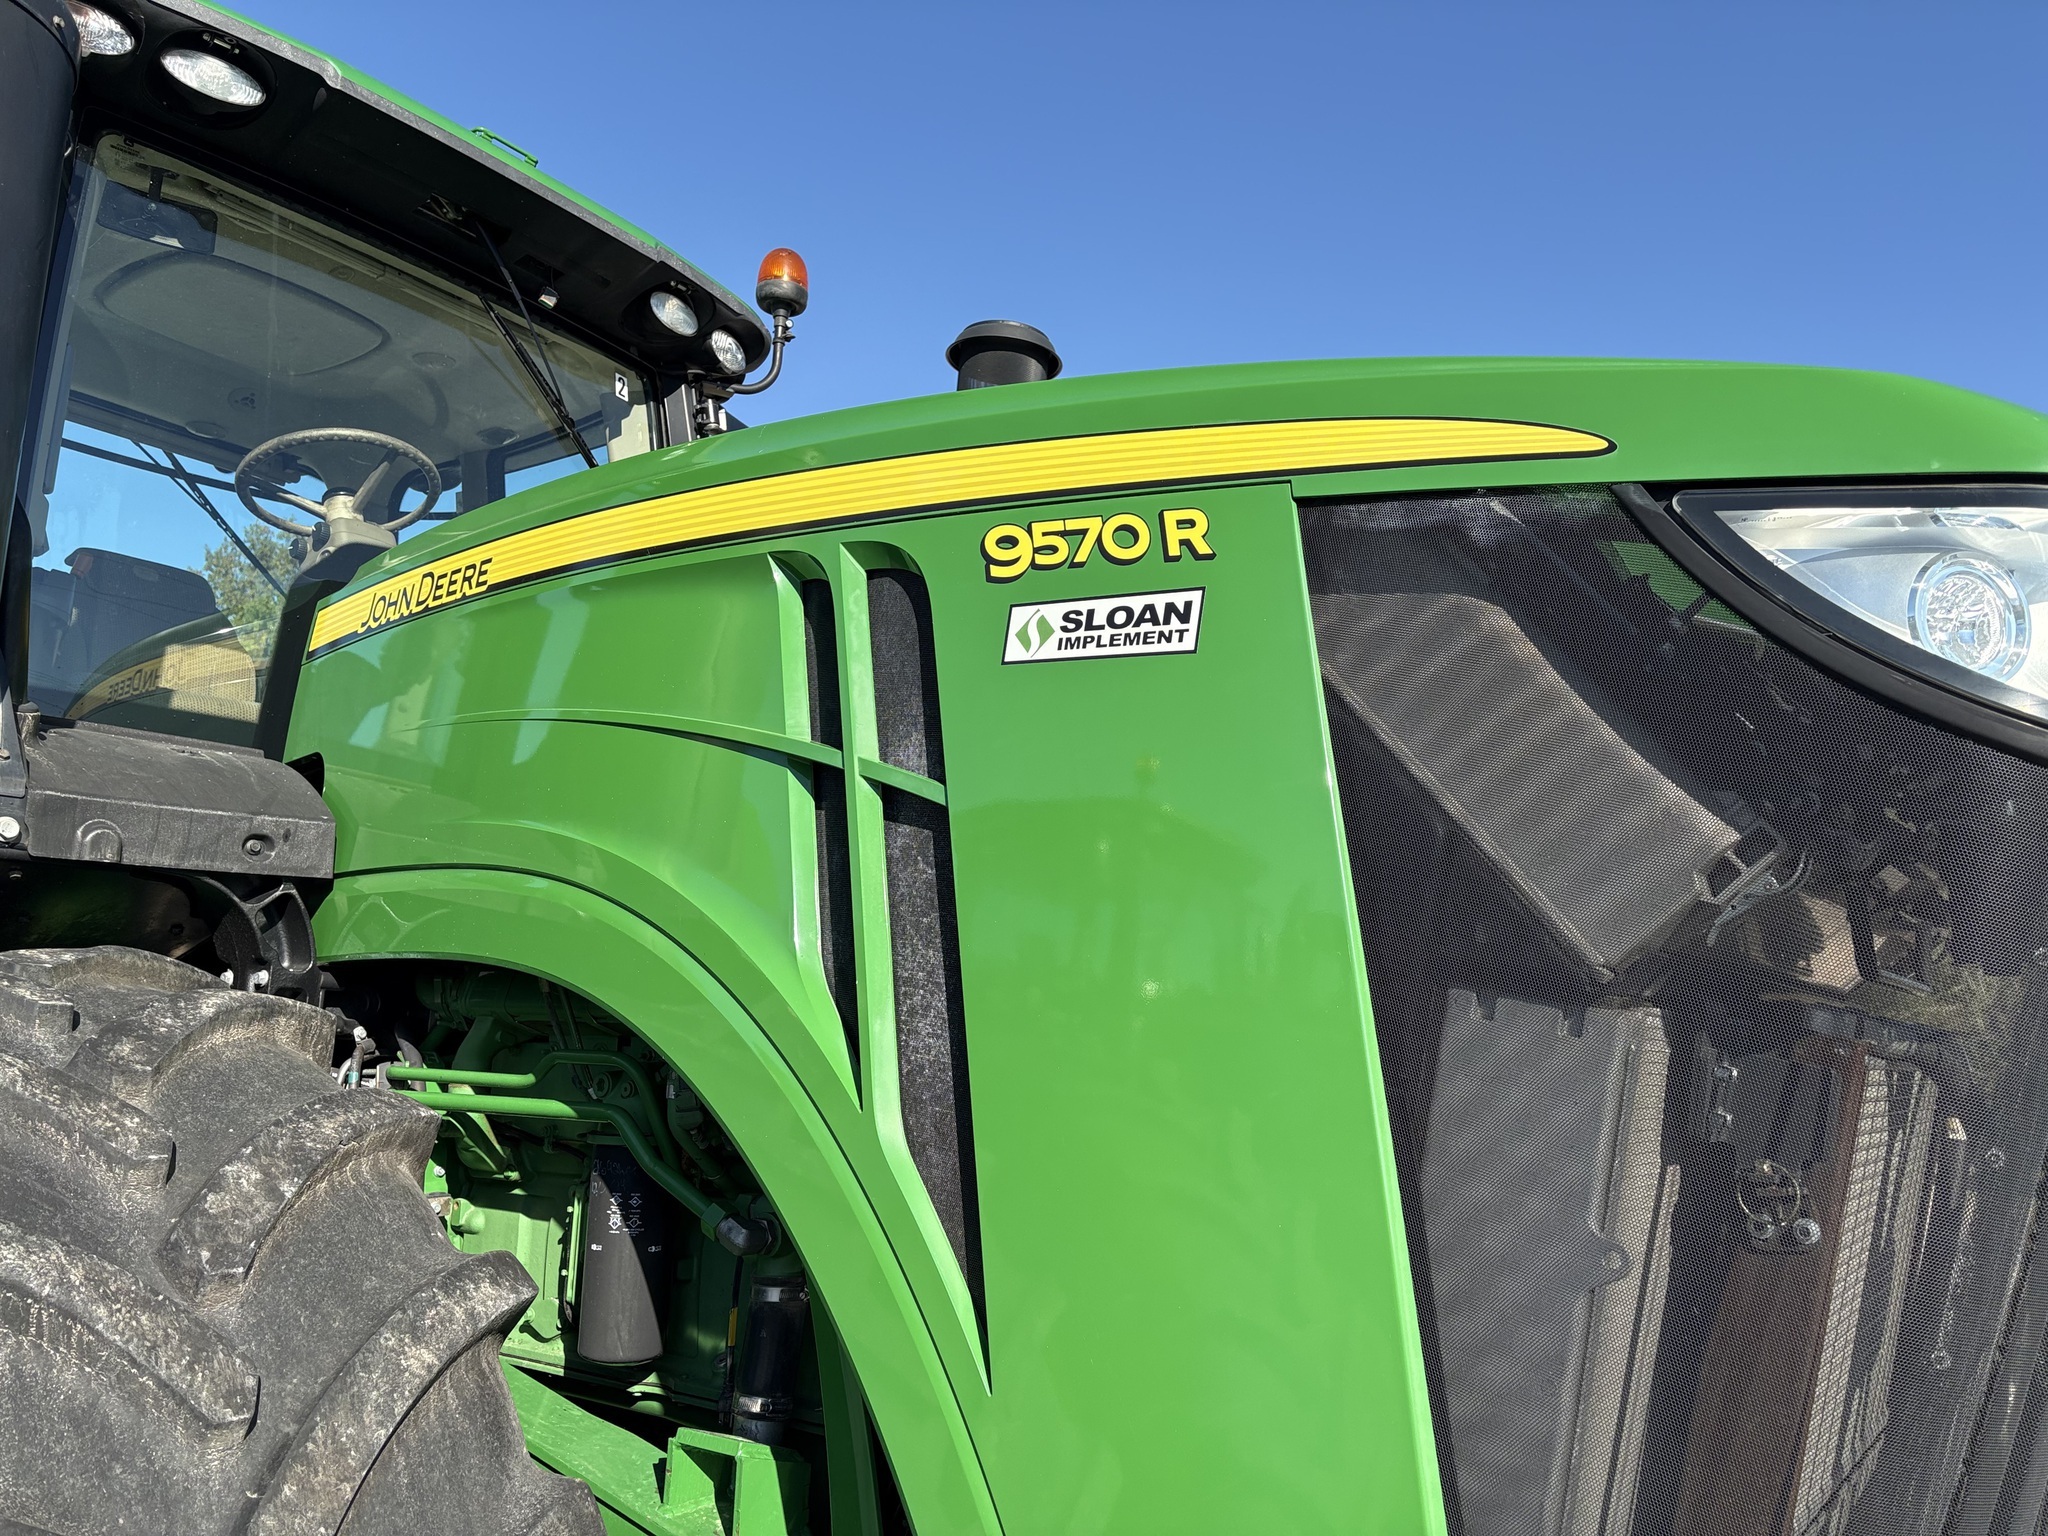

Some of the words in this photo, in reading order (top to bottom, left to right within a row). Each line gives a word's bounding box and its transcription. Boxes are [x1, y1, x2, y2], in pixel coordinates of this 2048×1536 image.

[980, 513, 1151, 584] 9570
[1158, 507, 1217, 563] R
[360, 582, 416, 630] JOHN
[415, 557, 493, 607] DEERE
[1060, 600, 1193, 633] SLOAN
[1057, 629, 1190, 651] IMPLEMENT
